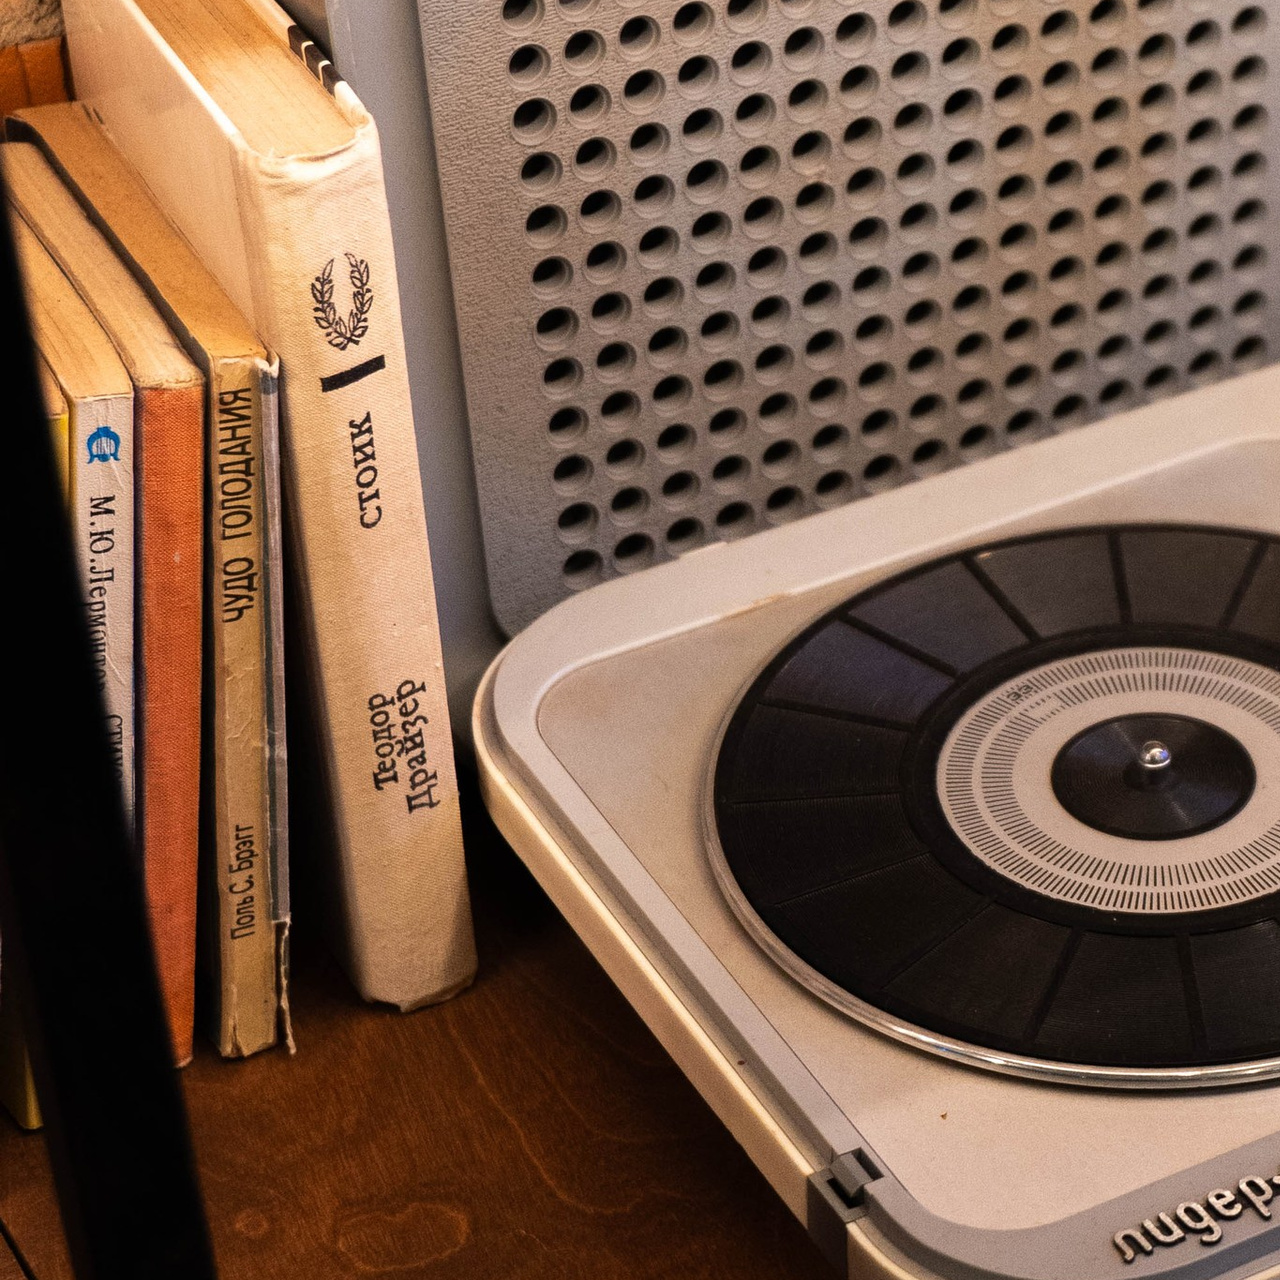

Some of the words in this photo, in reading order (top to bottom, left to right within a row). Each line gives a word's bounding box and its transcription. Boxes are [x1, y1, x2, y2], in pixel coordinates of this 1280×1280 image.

[218, 387, 256, 542] ГОЛОДАНИЯ
[347, 410, 382, 529] СТОИК
[222, 556, 258, 624] ЧУДО
[367, 692, 399, 791] Теодор
[394, 679, 437, 814] Драйзер
[228, 824, 259, 874] Брэгг
[228, 874, 254, 895] С.
[230, 895, 256, 940] Поль
